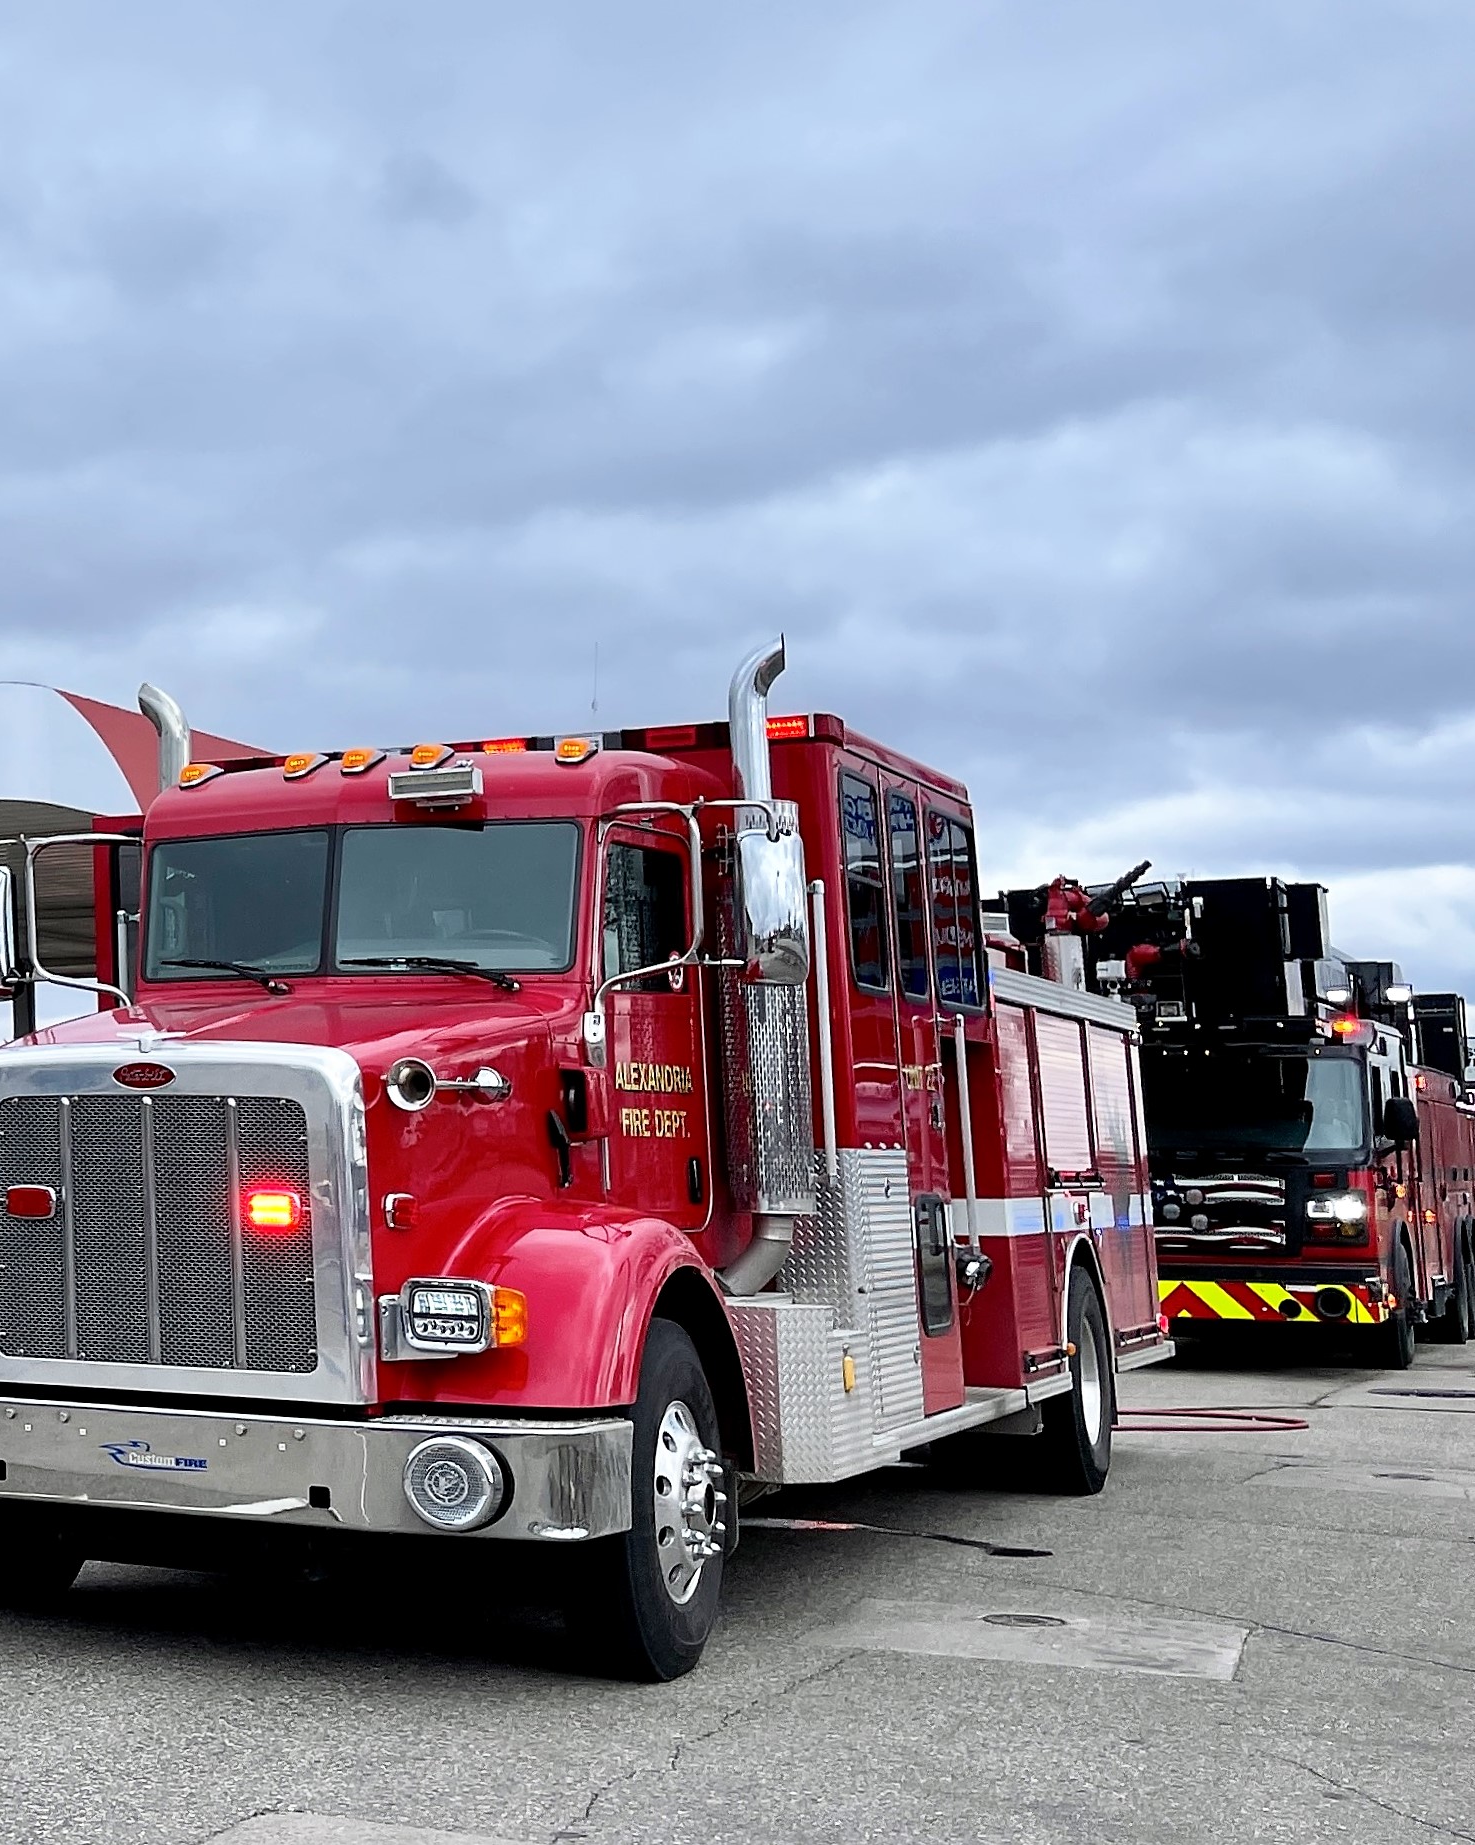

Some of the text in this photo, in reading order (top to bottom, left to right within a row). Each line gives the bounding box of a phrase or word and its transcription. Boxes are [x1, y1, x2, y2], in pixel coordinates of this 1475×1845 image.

[615, 1062, 693, 1094] ALEXANDRIA
[620, 1108, 691, 1139] FIRE DEPT.
